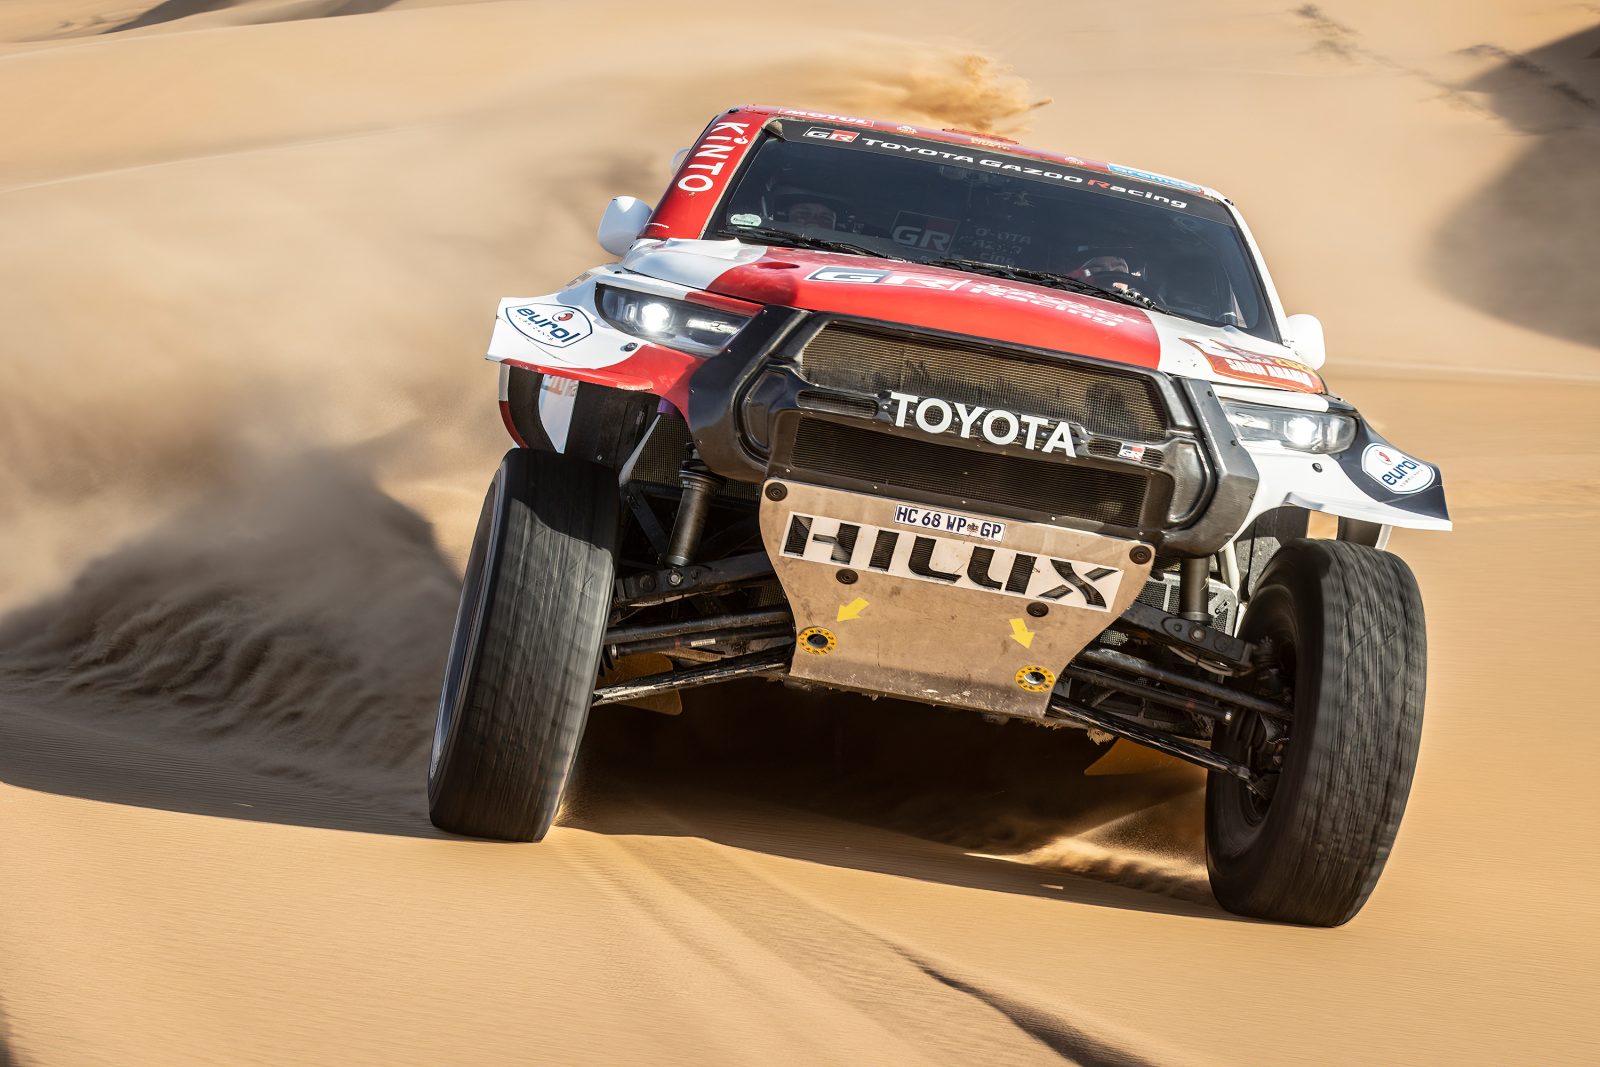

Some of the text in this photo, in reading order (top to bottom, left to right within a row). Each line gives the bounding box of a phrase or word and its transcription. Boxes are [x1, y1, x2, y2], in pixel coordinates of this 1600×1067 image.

[862, 137, 974, 163] TOYOTA
[979, 159, 1083, 183] GAZOO
[1087, 179, 1188, 209] Racing
[892, 224, 951, 252] GR
[812, 269, 956, 290] GR
[516, 308, 581, 342] eurol
[890, 391, 1077, 458] TOYOTA
[1381, 455, 1420, 486] eurol
[896, 506, 1002, 539] HC 68 WP GP
[784, 514, 1120, 608] HILUX
